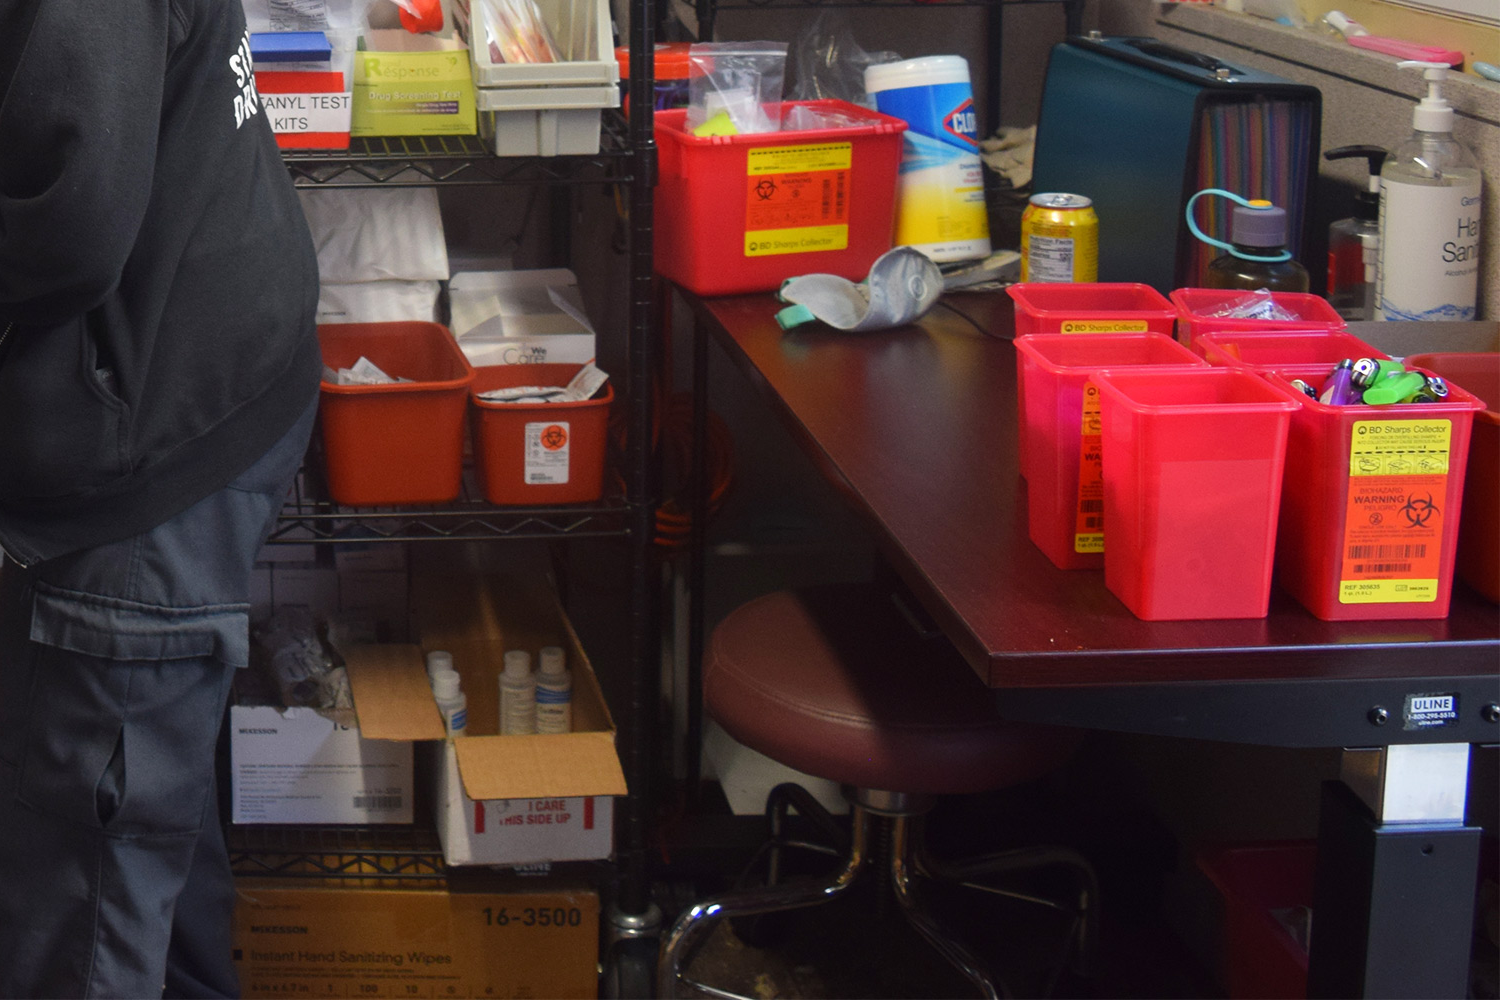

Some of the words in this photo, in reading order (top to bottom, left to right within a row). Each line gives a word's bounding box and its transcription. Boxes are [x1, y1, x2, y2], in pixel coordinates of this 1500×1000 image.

[369, 90, 391, 101] Drug
[393, 91, 439, 101] Screening
[442, 90, 461, 99] Test
[311, 96, 350, 110] TEST
[274, 117, 309, 130] KITS
[759, 241, 772, 250] BD
[773, 239, 799, 251] Sharps
[800, 237, 833, 247] Collector
[1089, 325, 1112, 333] Sharps
[503, 348, 546, 366] Care
[531, 347, 547, 356] We
[1385, 426, 1411, 435] Sharps
[1414, 425, 1447, 434] Collector
[1354, 495, 1405, 504] WARNING
[1414, 698, 1450, 710] ULINE
[536, 800, 565, 811] CARE
[527, 814, 552, 825] SIDE
[556, 813, 570, 824] UP
[482, 908, 583, 926] 16-3500
[251, 950, 294, 963] Instant
[299, 950, 335, 963] Hand
[340, 950, 403, 967] Sanitizing
[407, 951, 452, 967] Wipes
